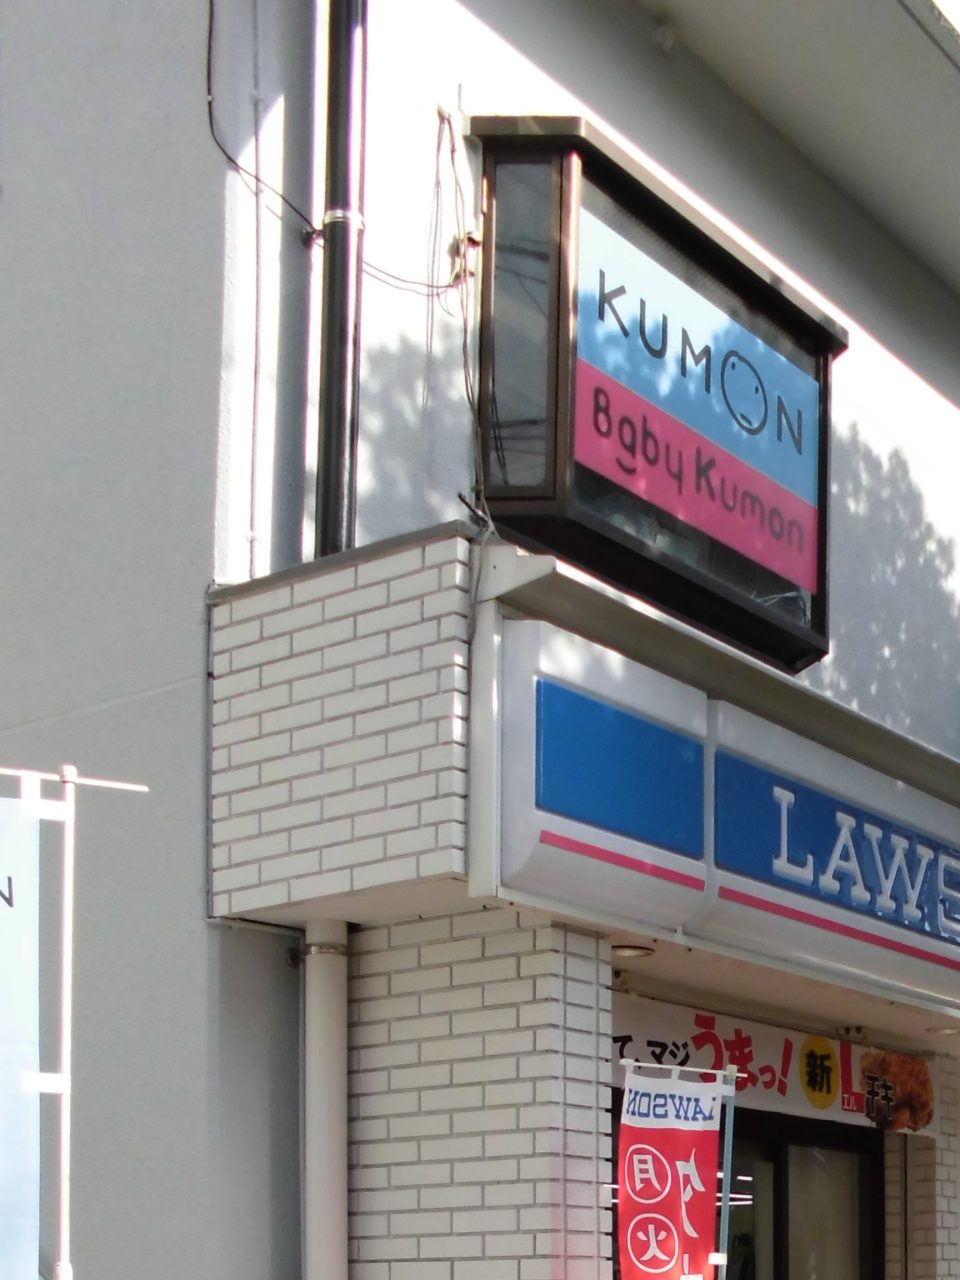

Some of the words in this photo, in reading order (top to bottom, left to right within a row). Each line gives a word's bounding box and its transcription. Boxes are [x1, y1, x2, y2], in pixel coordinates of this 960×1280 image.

[598, 268, 803, 456] KUMON
[593, 387, 684, 497] Baby
[695, 447, 803, 555] Kumon
[805, 1049, 832, 1095] 新
